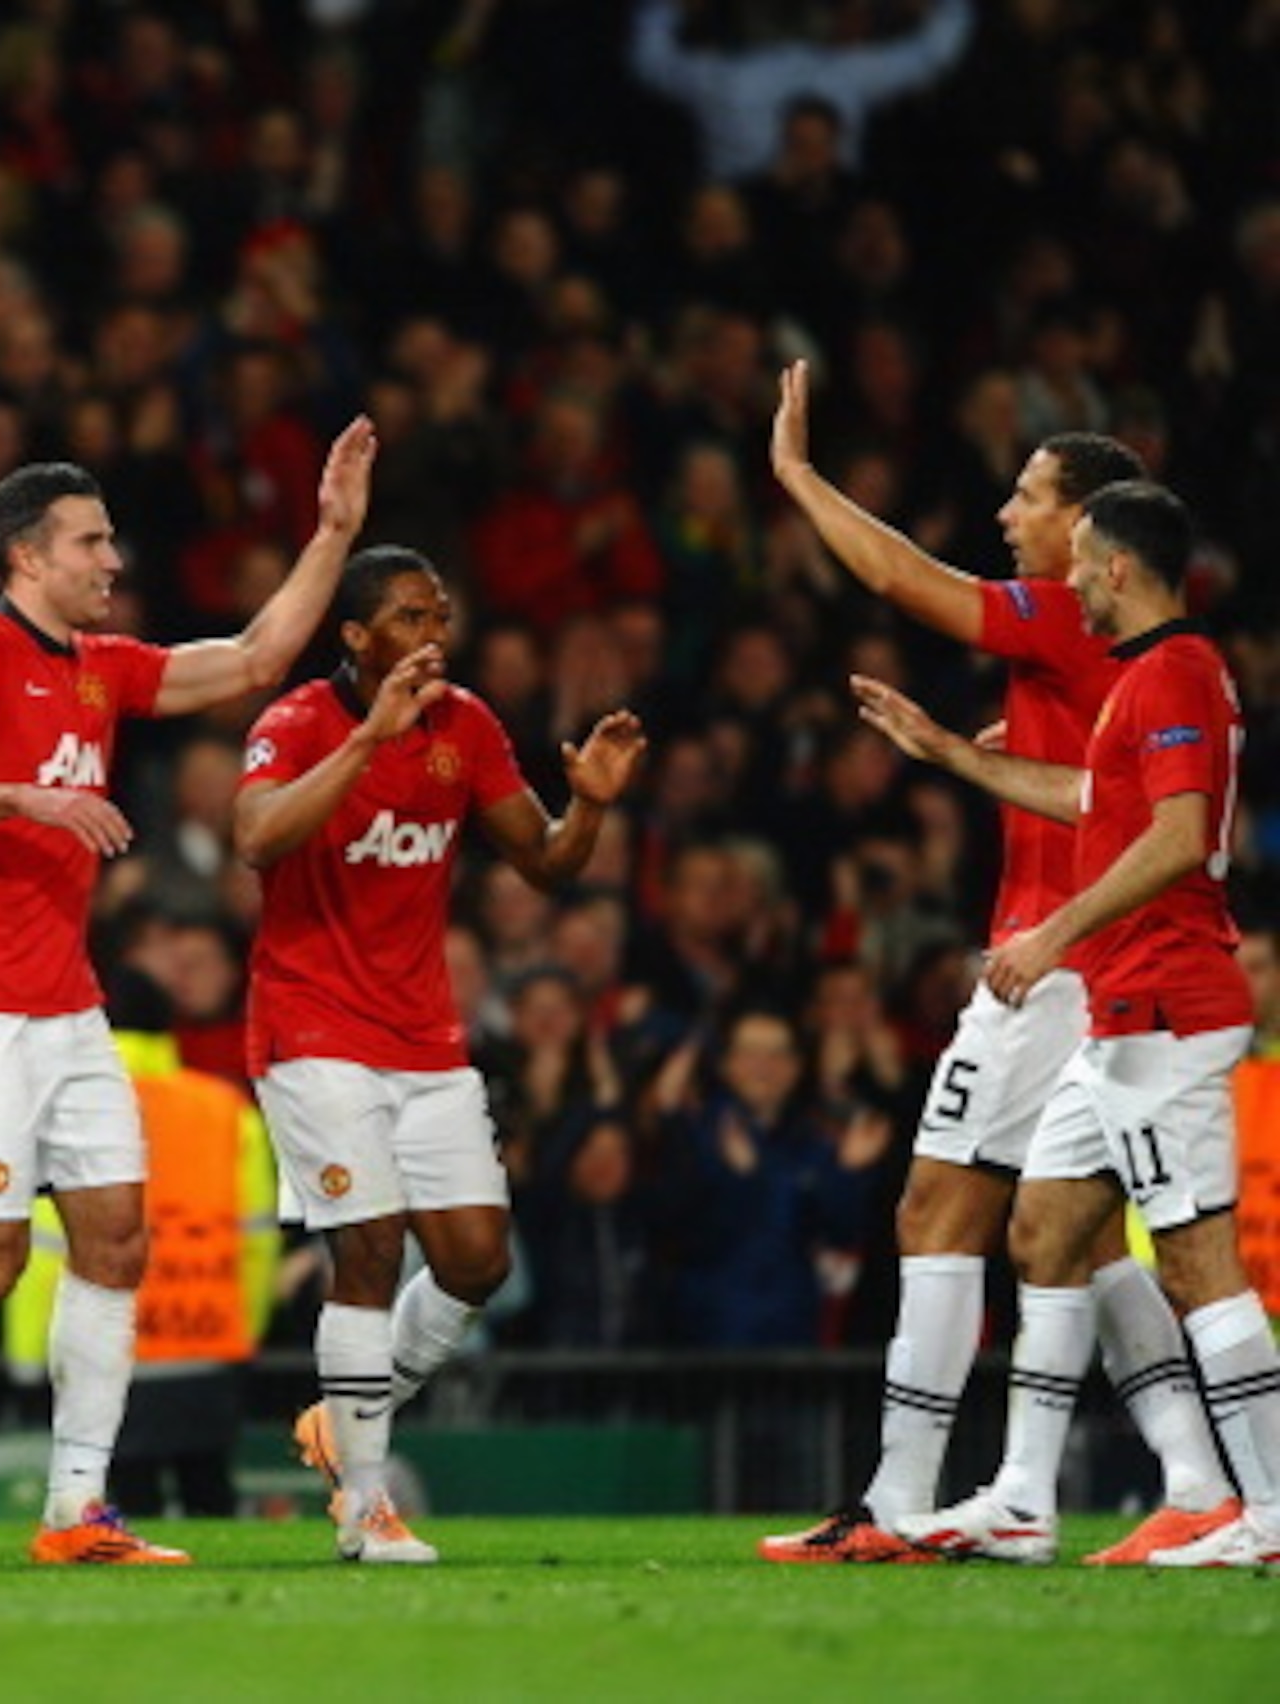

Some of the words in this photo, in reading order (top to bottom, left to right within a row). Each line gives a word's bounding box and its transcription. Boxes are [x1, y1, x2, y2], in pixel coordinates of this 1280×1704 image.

[344, 808, 457, 867] AON
[937, 1060, 979, 1122] 5
[1121, 1126, 1171, 1191] 11
